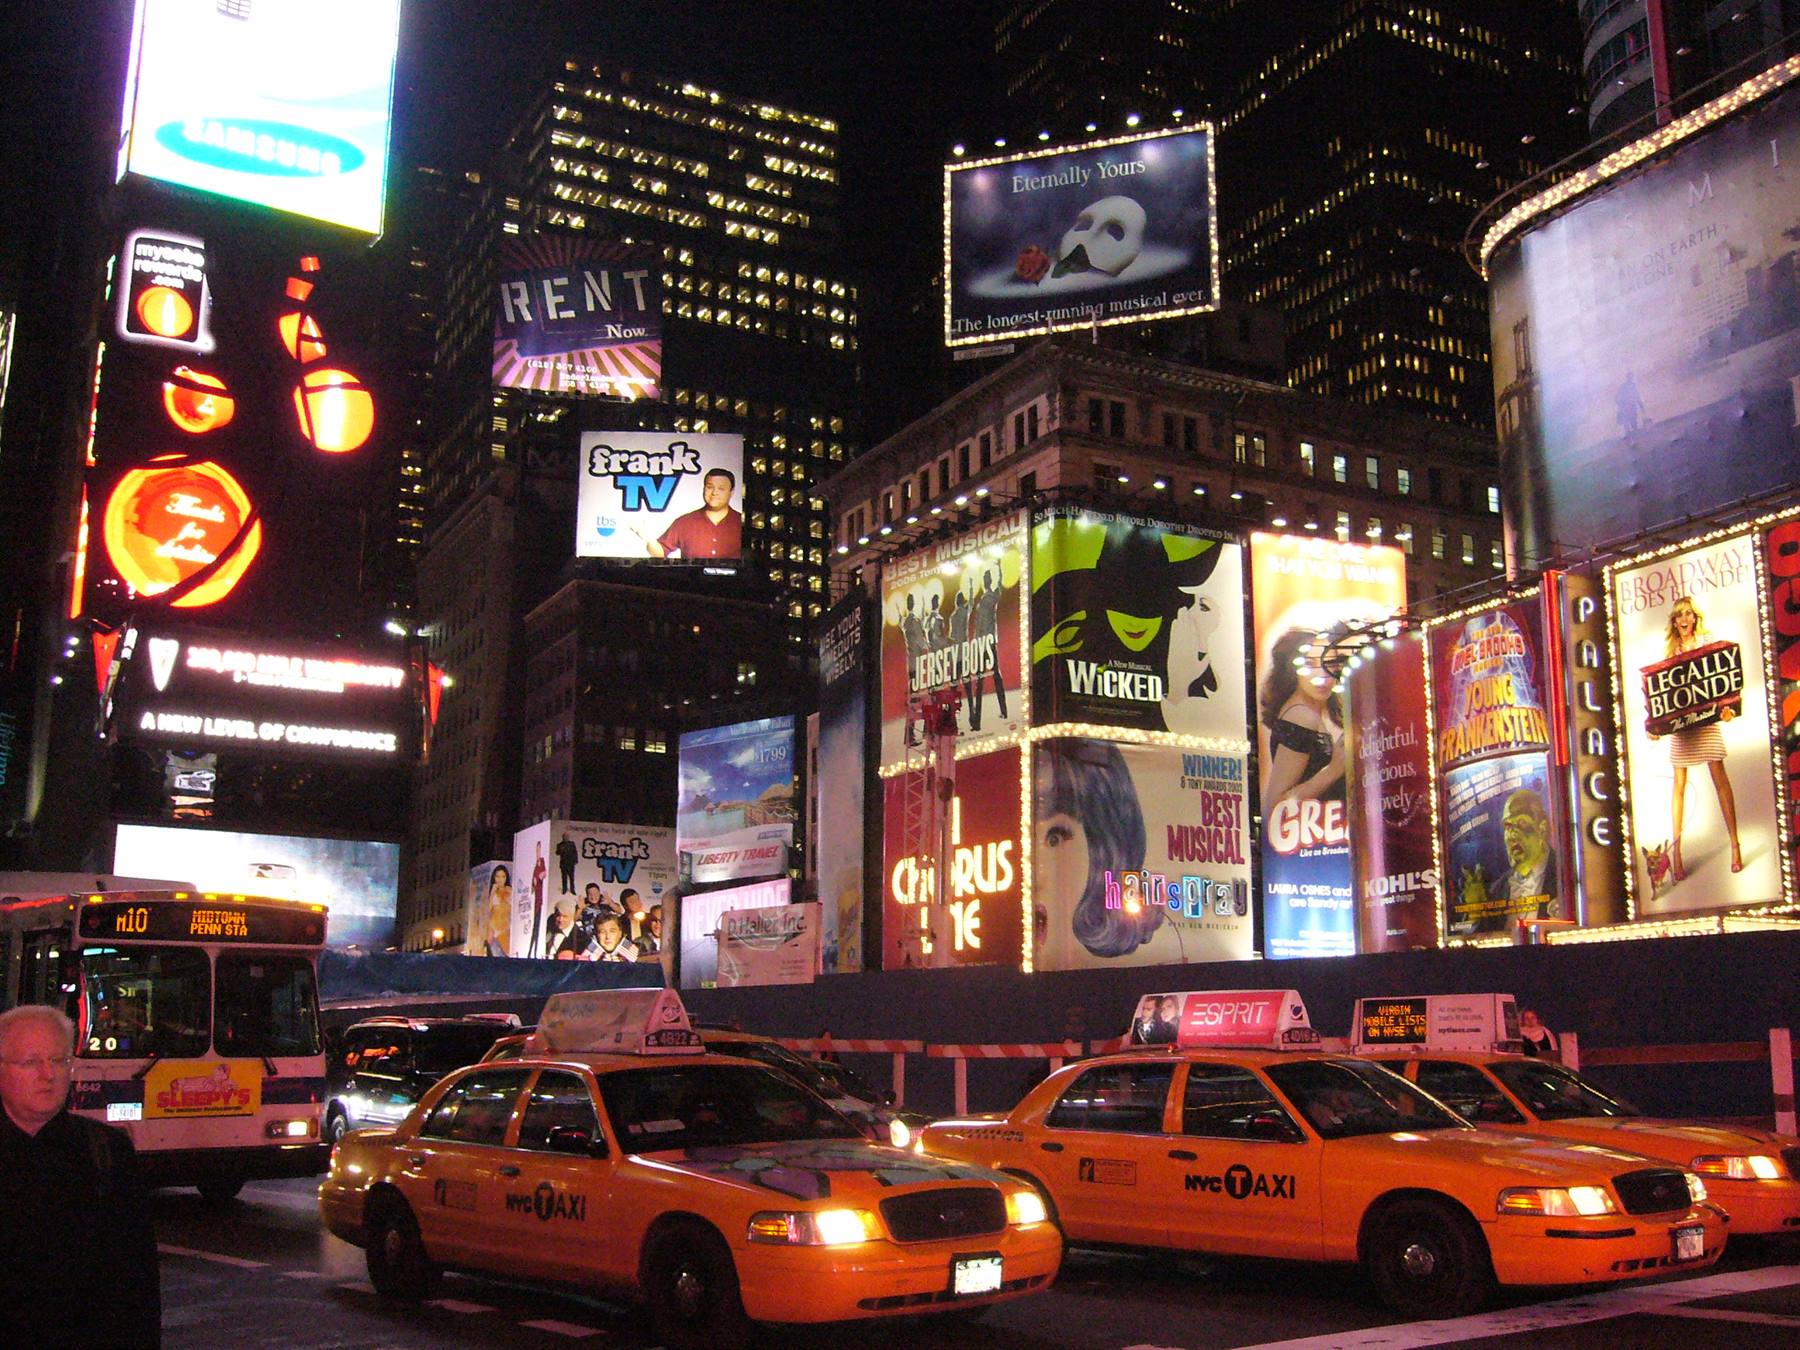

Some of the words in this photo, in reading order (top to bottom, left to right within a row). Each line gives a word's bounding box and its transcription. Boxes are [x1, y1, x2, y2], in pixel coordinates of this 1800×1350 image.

[1012, 166, 1091, 193] Eternally
[1097, 159, 1147, 179] Yours
[501, 270, 649, 323] RENT
[952, 316, 982, 333] The
[987, 302, 1104, 328] longest-running
[1109, 292, 1167, 313] musical
[589, 442, 701, 478] frank
[613, 473, 682, 513] TV
[596, 515, 617, 527] tbs
[884, 552, 931, 581] BEST
[935, 512, 1023, 563] MUSICAL
[1620, 545, 1747, 601] BROADWAY
[1621, 590, 1665, 615] GOES
[911, 643, 960, 692] JERSEY
[961, 633, 995, 678] BOYS
[1646, 645, 1739, 697] LEGALLY
[1465, 672, 1516, 717] YOUNG
[1649, 669, 1743, 719] BLONDE
[140, 711, 156, 731] A
[203, 717, 258, 740] LEVEL
[258, 722, 286, 742] OF
[1439, 707, 1551, 769] FRANKENSTEIN
[1577, 596, 1613, 846] PALACE
[1201, 790, 1243, 830] BEST
[582, 837, 650, 860] frank
[697, 850, 738, 865] LIBERTY
[742, 845, 779, 861] TRAVEL
[1166, 824, 1246, 865] MUSICAL
[597, 856, 640, 884] TV
[1364, 869, 1440, 898] KOHL'S
[1104, 869, 1248, 919] hairspray
[190, 922, 222, 935] PENN
[224, 924, 248, 936] STA
[192, 910, 247, 924] MIDTOWN
[1190, 1001, 1270, 1026] ESPRIT
[1363, 1015, 1395, 1027] MOBILE
[1399, 1014, 1427, 1026] LISTS
[156, 1088, 252, 1109] SLEEPY'S
[1184, 1173, 1223, 1194] NYC
[1226, 1164, 1296, 1200] TAXI
[505, 1193, 533, 1214] NYC
[535, 1183, 587, 1222] TAXI
